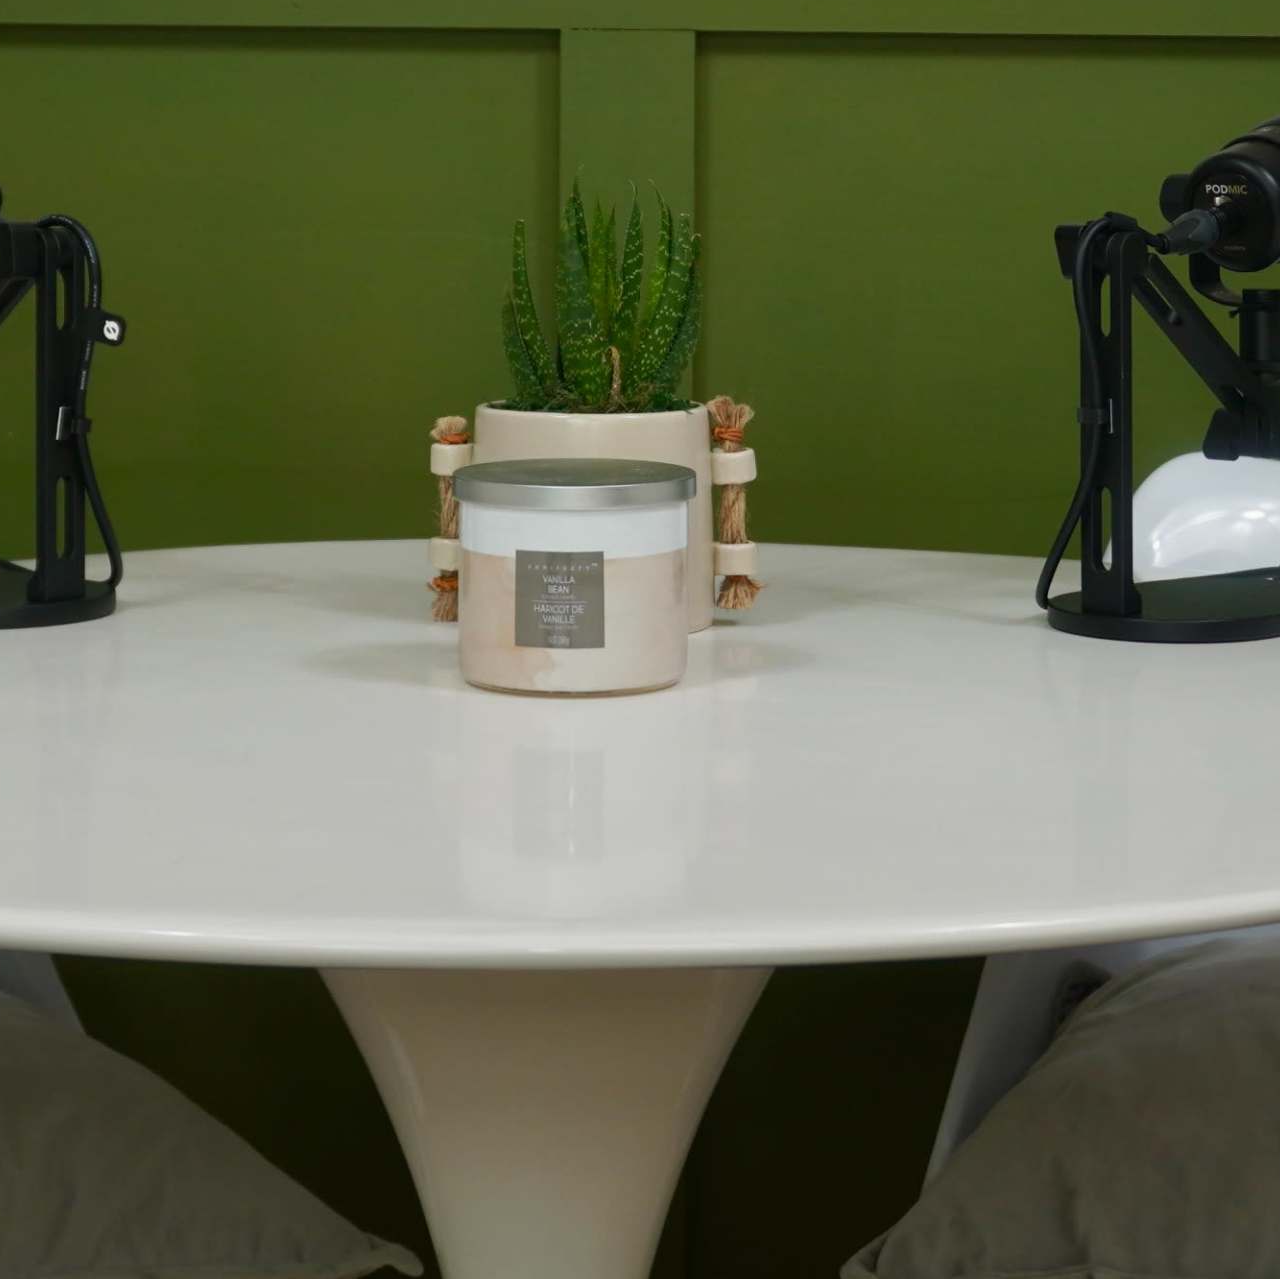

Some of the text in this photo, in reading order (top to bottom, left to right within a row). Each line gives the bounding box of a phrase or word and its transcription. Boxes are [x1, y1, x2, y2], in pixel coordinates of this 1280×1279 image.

[1204, 183, 1249, 195] PODMIC
[542, 574, 576, 585] VANILLA
[533, 603, 585, 614] HARICOT DE
[542, 614, 577, 625] VANILLE
